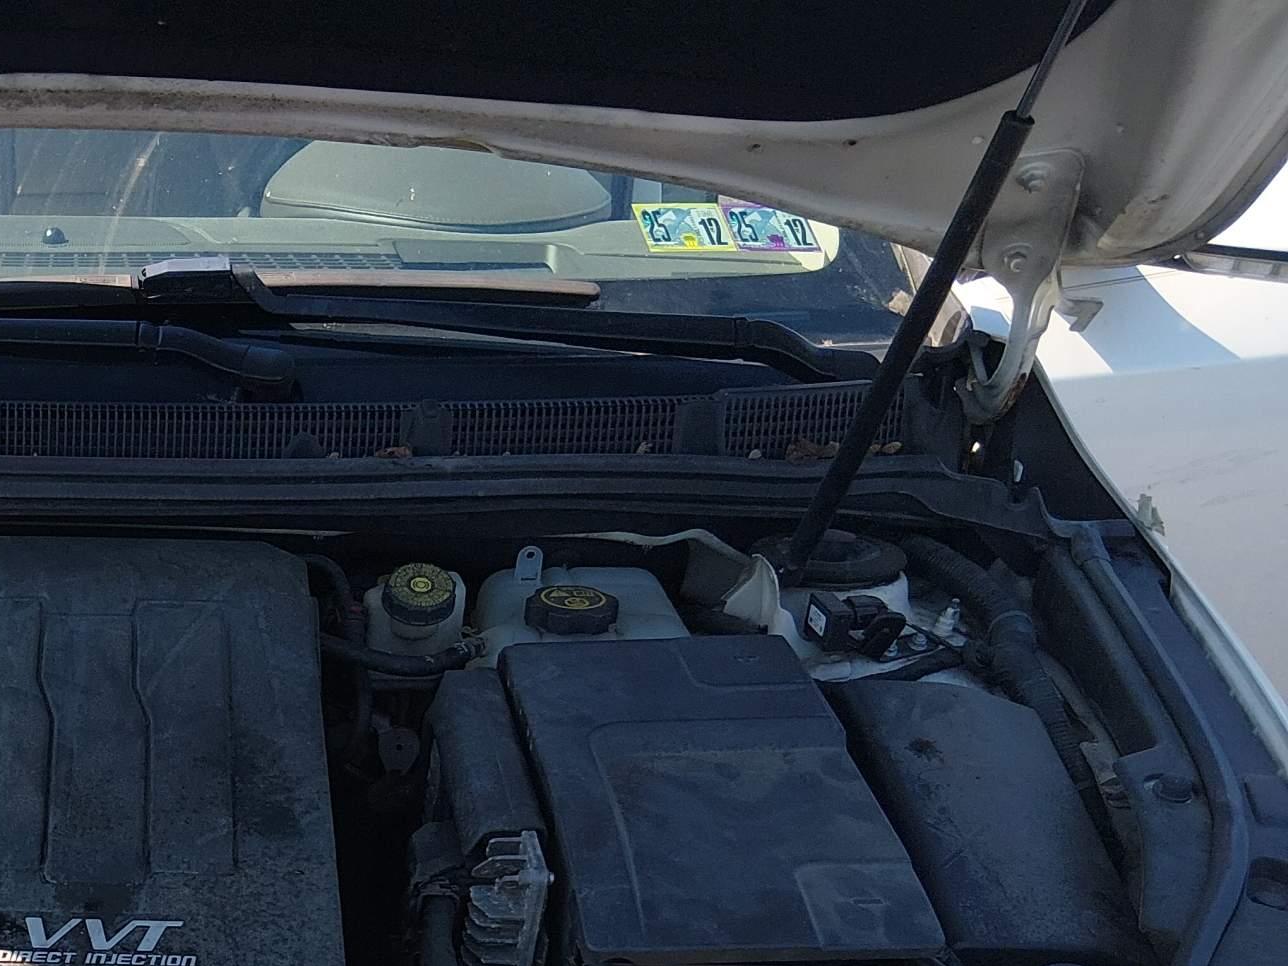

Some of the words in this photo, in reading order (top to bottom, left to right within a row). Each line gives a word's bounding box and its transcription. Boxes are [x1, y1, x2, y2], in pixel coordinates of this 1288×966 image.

[641, 210, 671, 242] 25
[698, 217, 728, 245] 12
[729, 211, 760, 242] 25
[784, 218, 813, 246] 12
[25, 916, 184, 952] VVT
